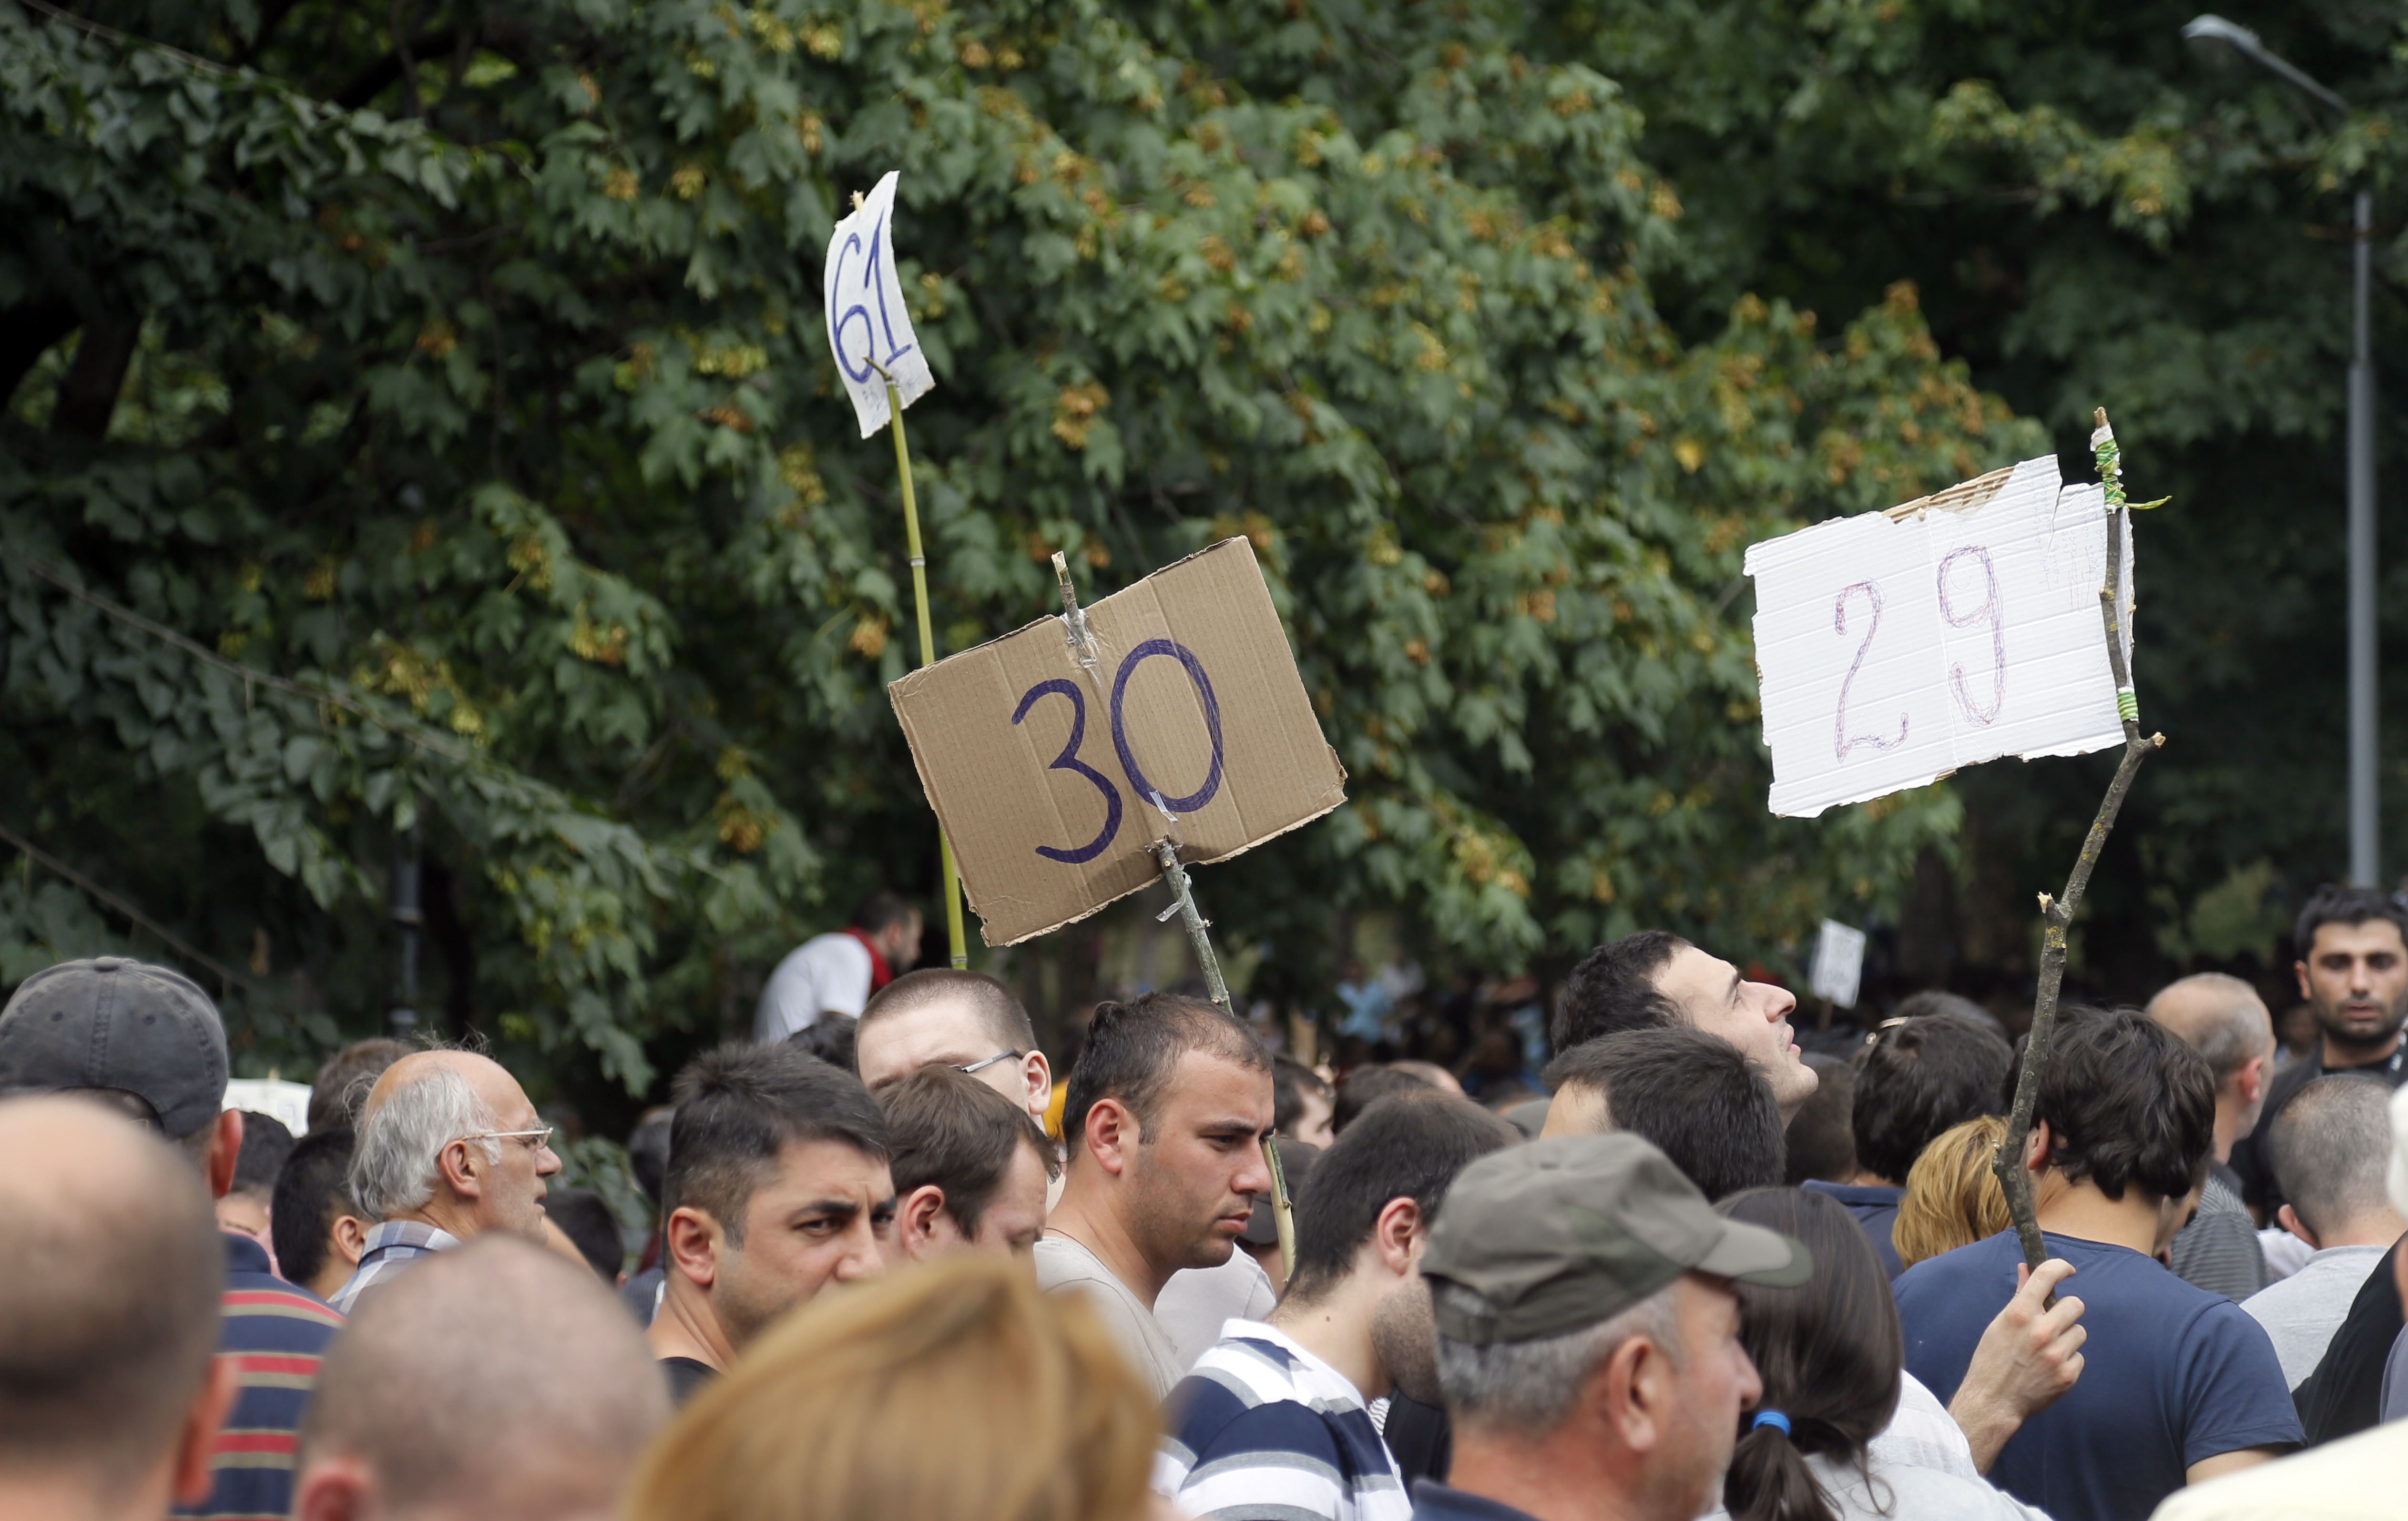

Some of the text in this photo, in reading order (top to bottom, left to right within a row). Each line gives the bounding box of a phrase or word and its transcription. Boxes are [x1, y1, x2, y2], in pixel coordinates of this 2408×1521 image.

[832, 207, 912, 383] 61
[1011, 638, 1223, 864] 30
[1835, 543, 2007, 765] 29
